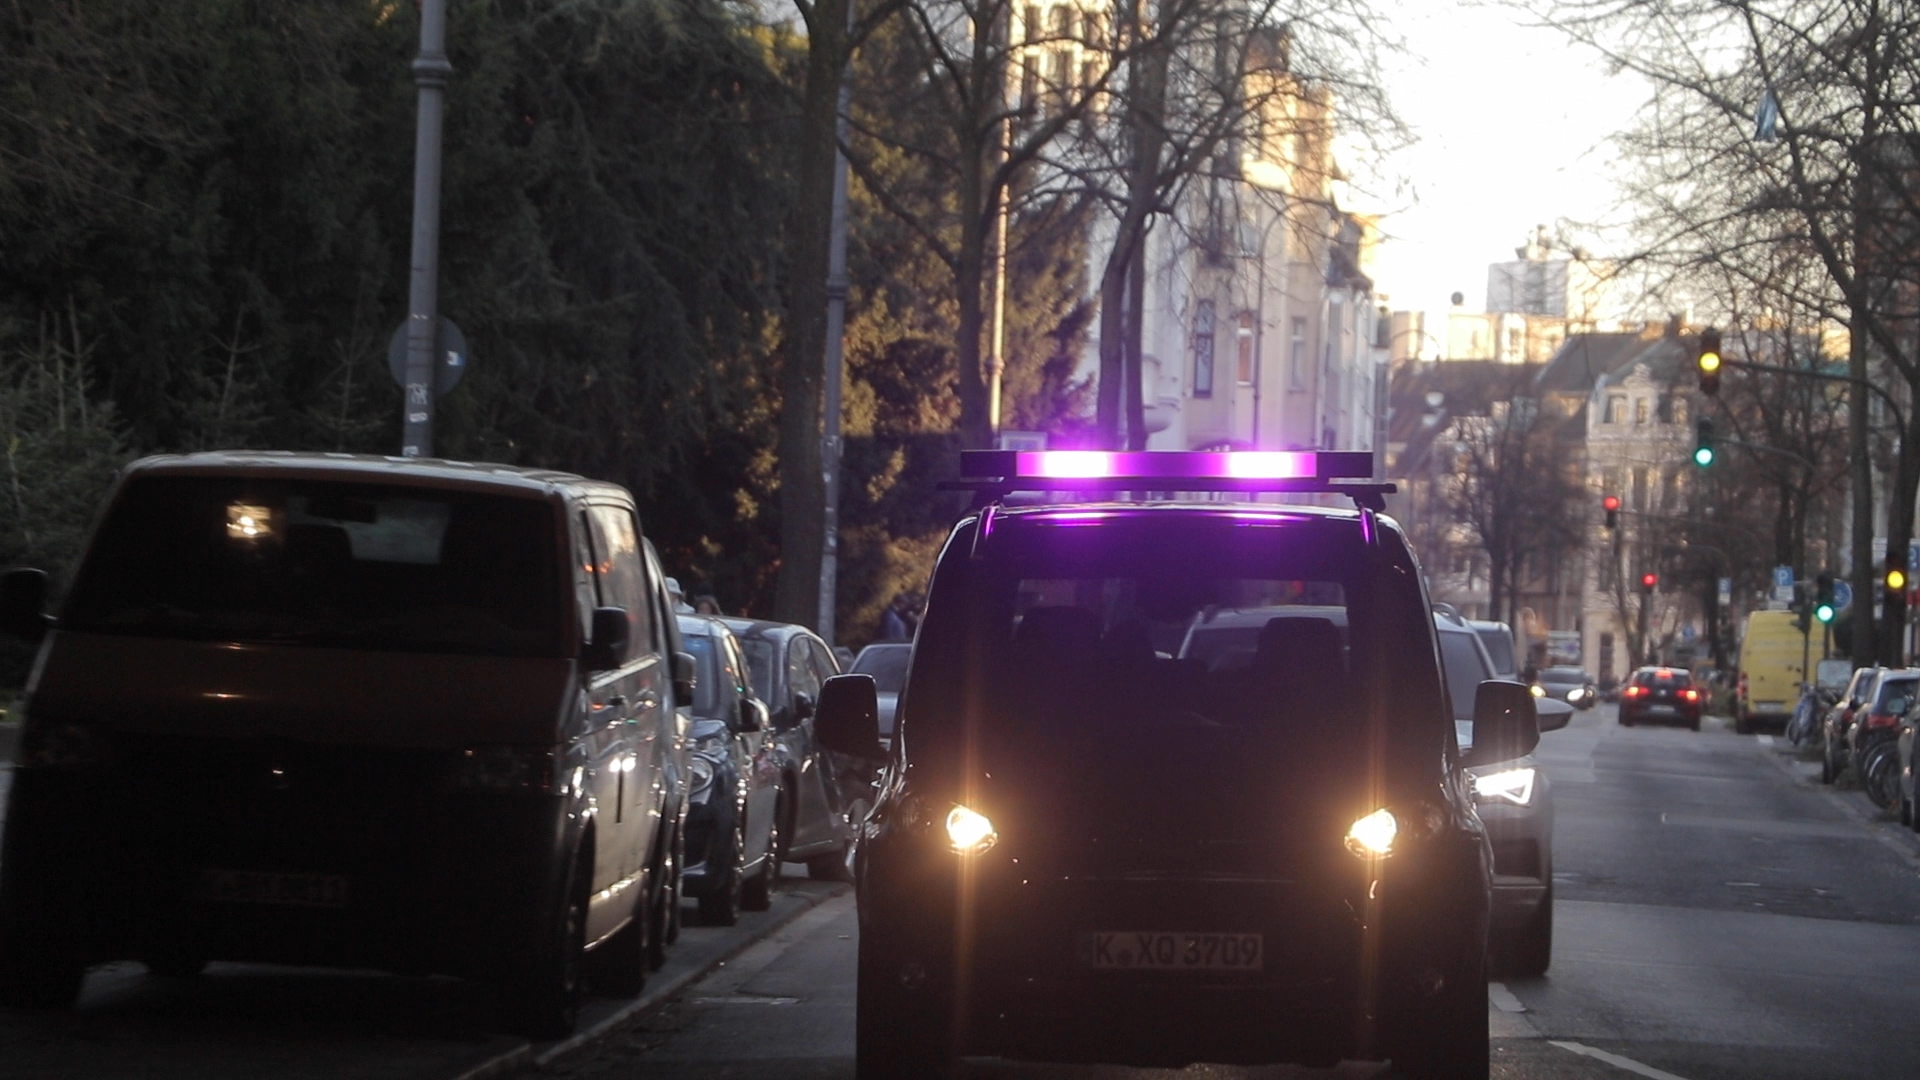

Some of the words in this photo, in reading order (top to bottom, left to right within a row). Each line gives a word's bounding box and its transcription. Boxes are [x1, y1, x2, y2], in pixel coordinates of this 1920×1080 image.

[1778, 570, 1789, 585] P
[1096, 935, 1115, 965] K
[1137, 935, 1175, 965] XQ
[1183, 935, 1260, 966] 3709
